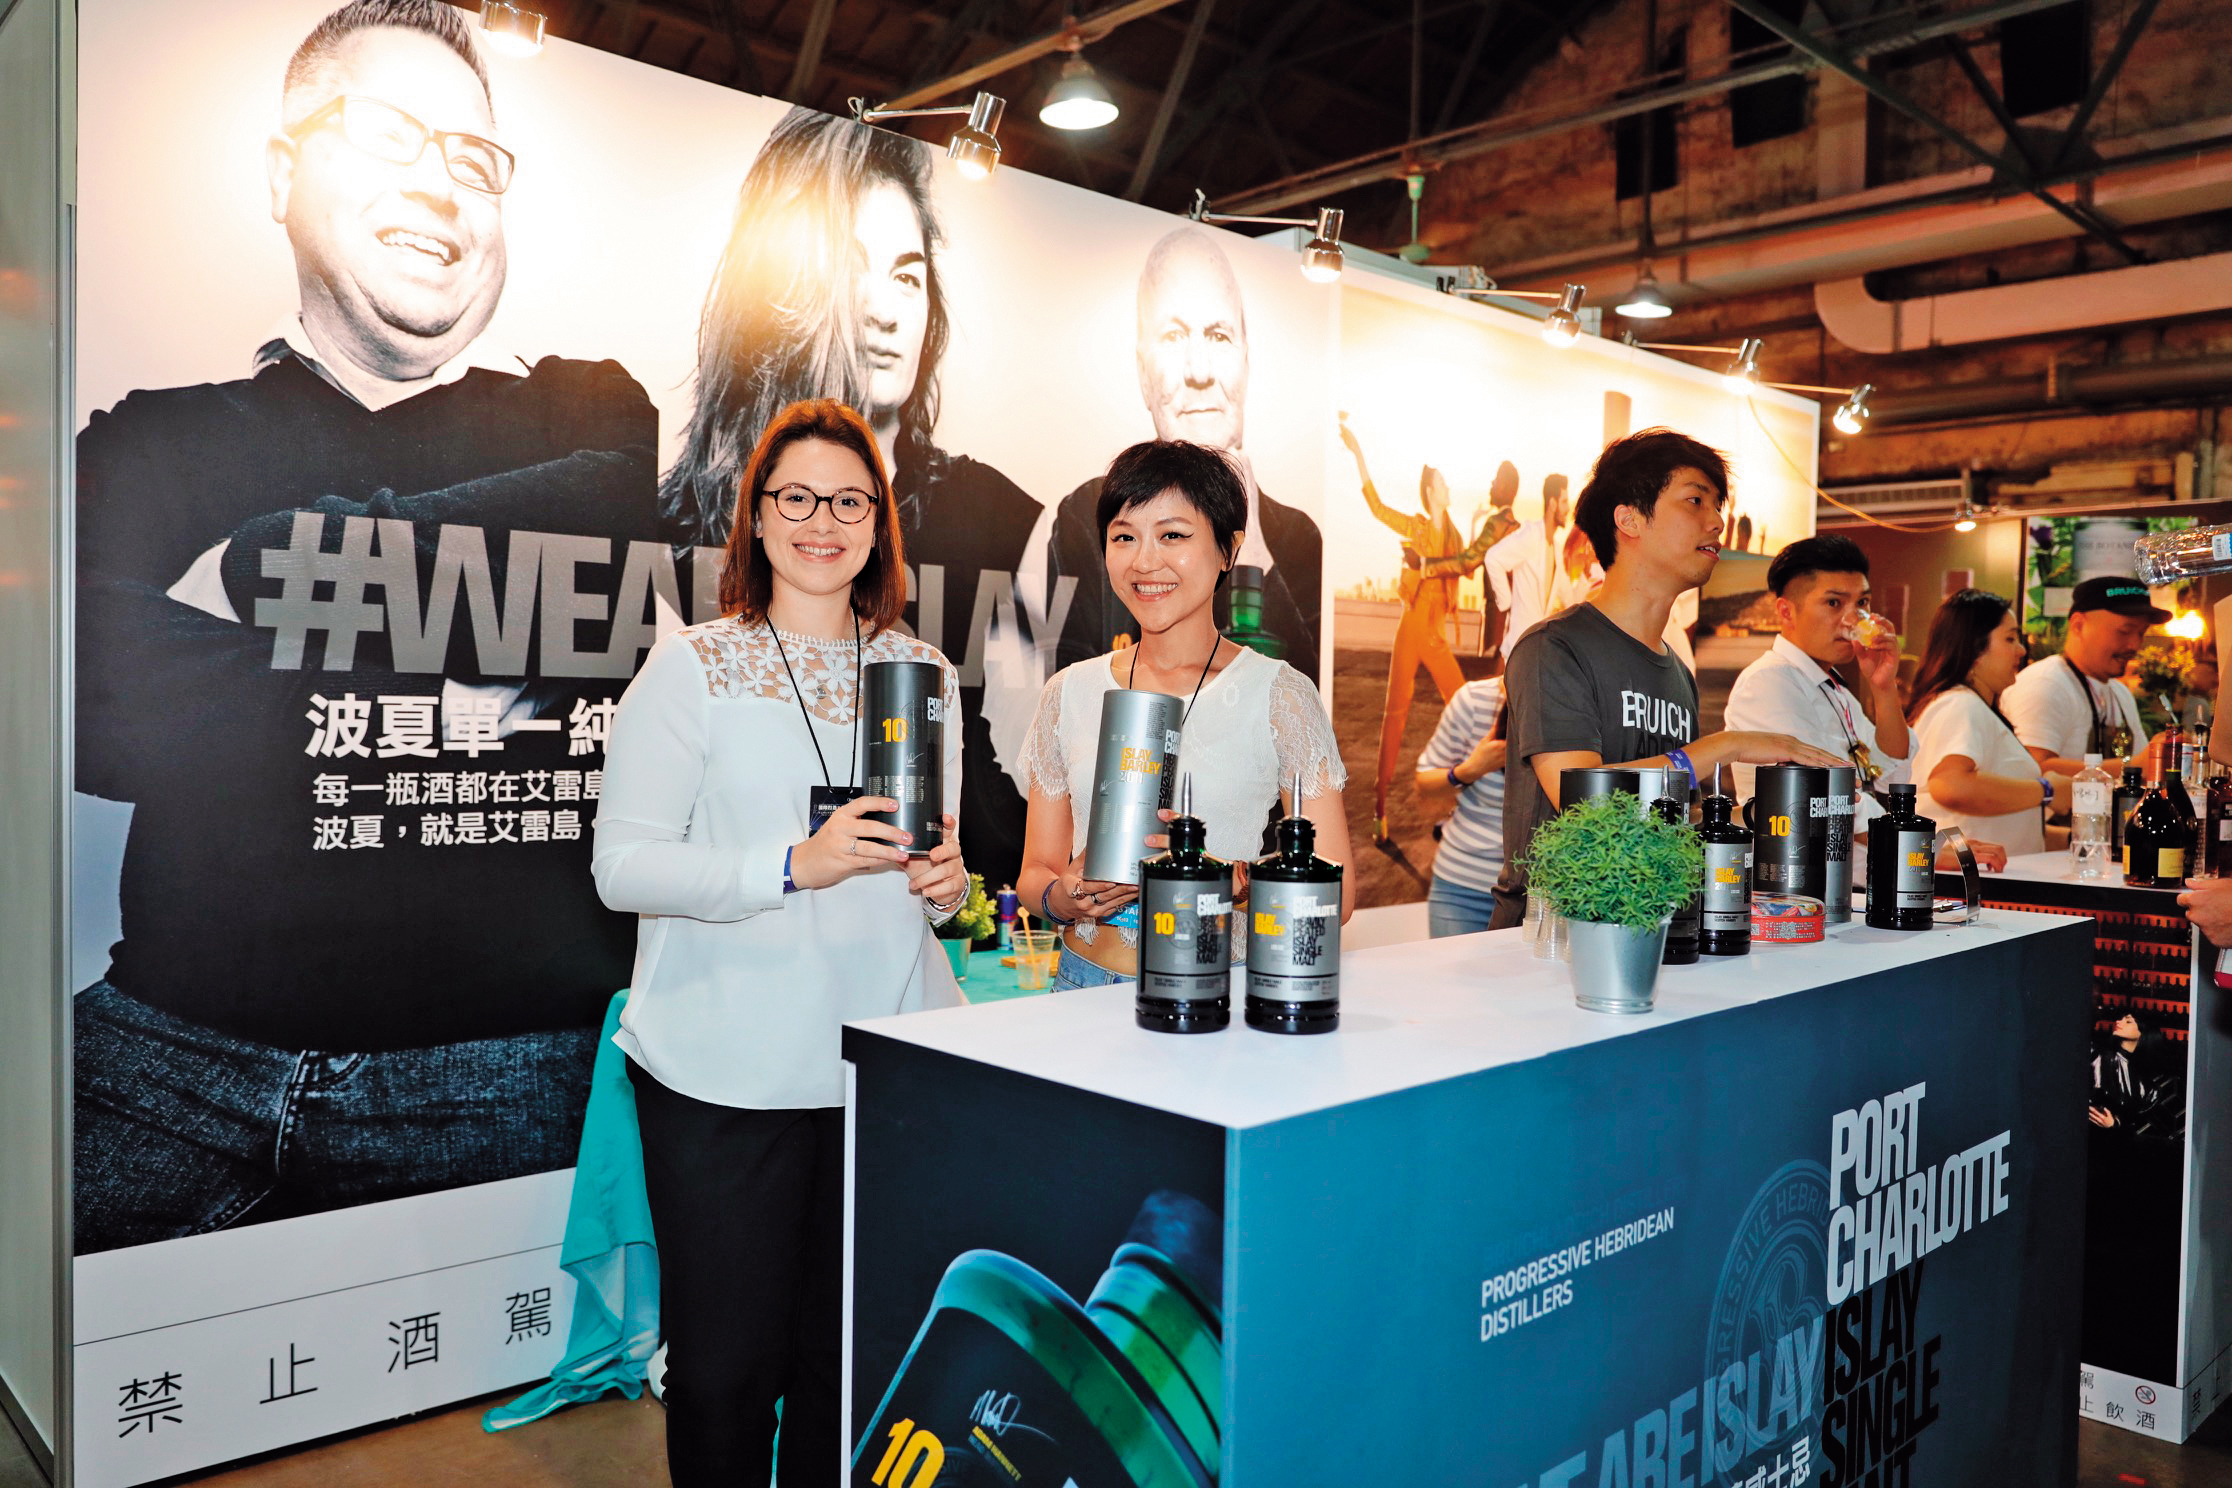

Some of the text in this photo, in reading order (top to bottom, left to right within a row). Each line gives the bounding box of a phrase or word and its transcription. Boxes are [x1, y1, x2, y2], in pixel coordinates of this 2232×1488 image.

[882, 718, 908, 742] 10
[1769, 815, 1790, 837] 10
[1154, 911, 1175, 935] 10
[1829, 1081, 1926, 1211] PORT
[1481, 1206, 1675, 1309] PROGRESSIVE HEBRIDEAN
[1826, 1129, 2011, 1306] CHARLOTTE
[1480, 1279, 1574, 1343] DISTILLERS
[1823, 1258, 1925, 1407] ISLAY
[1700, 1314, 1824, 1487] ISLAY
[1819, 1333, 1942, 1488] SINGLE
[871, 1417, 945, 1488] 10
